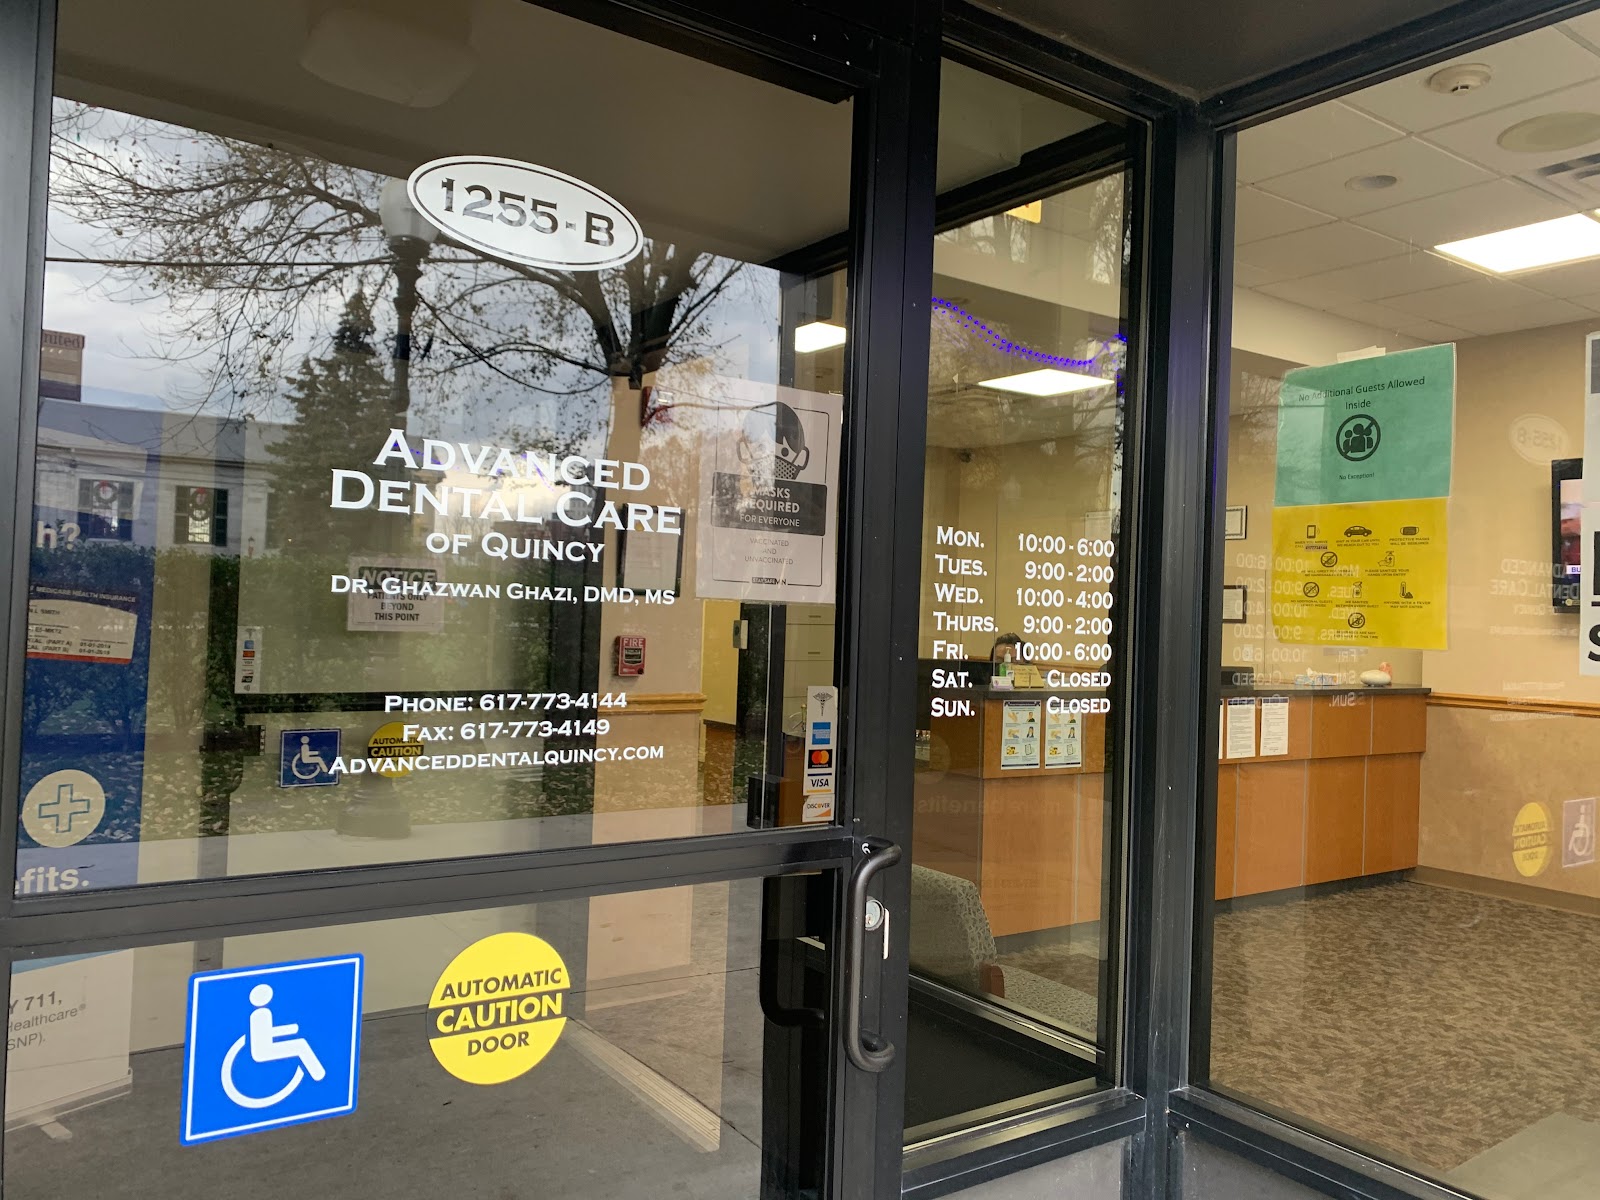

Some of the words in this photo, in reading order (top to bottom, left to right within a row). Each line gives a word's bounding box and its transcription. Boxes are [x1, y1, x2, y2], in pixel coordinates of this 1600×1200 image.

[441, 178, 614, 247] 1255-B
[1299, 394, 1310, 402] No
[1312, 386, 1353, 400] Additional
[1356, 382, 1386, 394] Guests
[1388, 376, 1426, 388] Allowed
[1345, 399, 1372, 410] Inside
[373, 428, 650, 491] ADVANCED
[1348, 472, 1375, 481] Exception!
[330, 468, 542, 525] DENTAL
[556, 491, 681, 536] CARE
[752, 486, 790, 499] MASKS
[740, 514, 757, 523] FOR
[758, 516, 800, 527] EVERYONE
[426, 532, 472, 555] OF
[481, 532, 605, 562] QUINCY
[749, 538, 790, 548] VACCINATED
[936, 526, 984, 548] MON.
[1018, 533, 1066, 554] 10:00
[1077, 538, 1114, 558] 6:00
[744, 556, 794, 566] UNVACCINATED
[934, 554, 988, 576] TUES.
[1025, 561, 1064, 581] 9:00
[1076, 564, 1114, 584] 2:00
[100, 594, 136, 602] INSURANCE
[331, 574, 374, 594] DR.
[381, 576, 500, 598] GHAZWAN
[506, 583, 577, 605] GHAZI,
[584, 586, 639, 606] DMD,
[645, 589, 675, 605] MS
[934, 583, 984, 604] WED.
[1016, 588, 1064, 608] 10:00
[1076, 591, 1114, 610] 4:00
[374, 612, 393, 620] THIS
[396, 613, 420, 622] POINT
[933, 611, 998, 632] THURS.
[1024, 615, 1064, 634] 9:00
[1074, 617, 1112, 635] 2:00
[624, 638, 644, 646] FIRE
[933, 640, 968, 660] FRI.
[1015, 642, 1062, 661] 10:00
[1074, 644, 1112, 662] 6:00
[932, 669, 972, 688] SAT.
[1047, 670, 1112, 688] CLOSED
[384, 695, 473, 713] PHONE:
[479, 692, 627, 712] 617-773-4144
[931, 697, 976, 717] SUN.
[1046, 696, 1110, 714] CLOSED
[372, 737, 420, 745] AUTOMTIC
[402, 724, 454, 741] FAX:
[460, 719, 610, 739] 617-773-4149
[328, 746, 664, 775] ADVANCEDDENTALQUINCY.COM
[371, 746, 422, 757] CAUTION
[810, 778, 829, 788] VISA
[15, 866, 89, 895] fits.
[440, 968, 562, 1000] AUTOMATIC
[24, 990, 62, 1011] 711,
[436, 993, 562, 1034] CAUTION
[468, 1031, 530, 1056] DOOR
